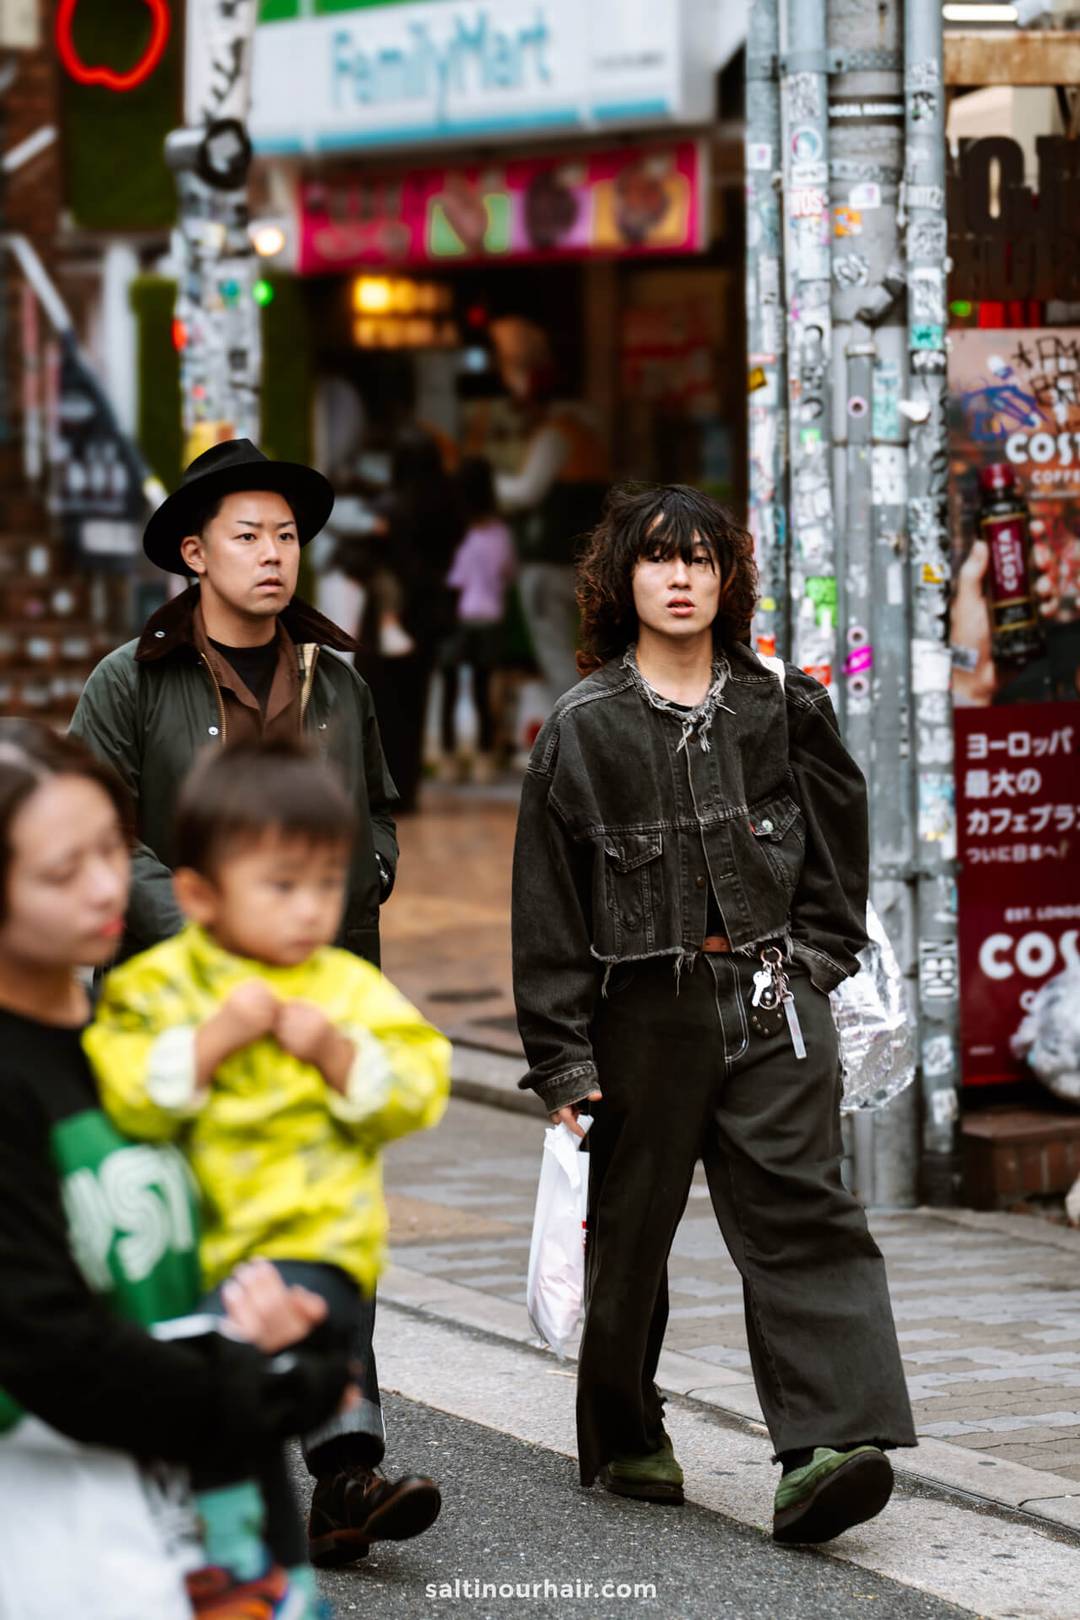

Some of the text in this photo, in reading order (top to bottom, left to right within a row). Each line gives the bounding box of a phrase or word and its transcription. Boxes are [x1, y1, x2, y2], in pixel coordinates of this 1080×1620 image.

[998, 529, 1018, 592] COSTA
[967, 727, 1073, 759] ヨーロッパ
[966, 768, 1041, 798] 最大の
